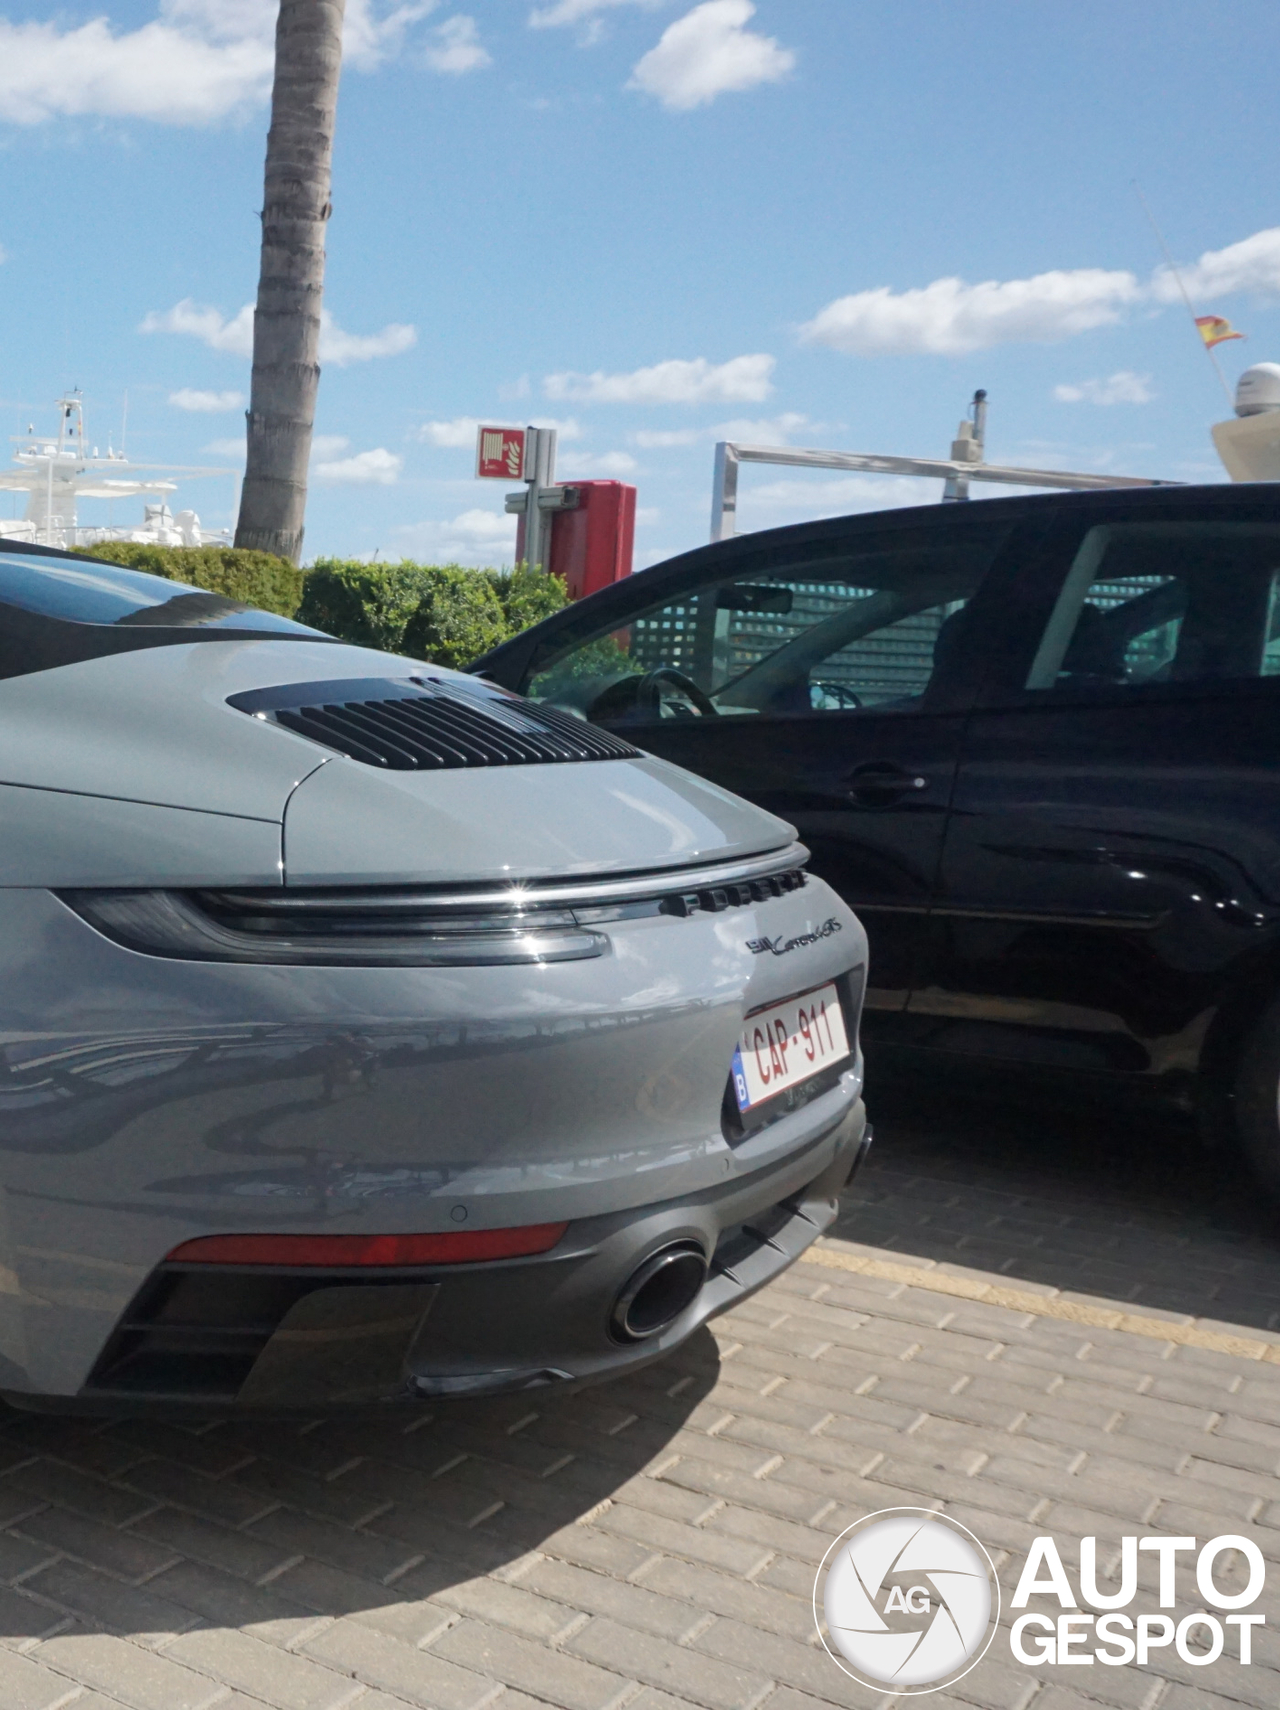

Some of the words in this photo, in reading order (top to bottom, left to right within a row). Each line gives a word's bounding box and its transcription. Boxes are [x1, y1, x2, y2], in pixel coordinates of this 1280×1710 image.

[745, 936, 773, 954] 911
[752, 1000, 835, 1085] CAP-911
[736, 1073, 747, 1101] B
